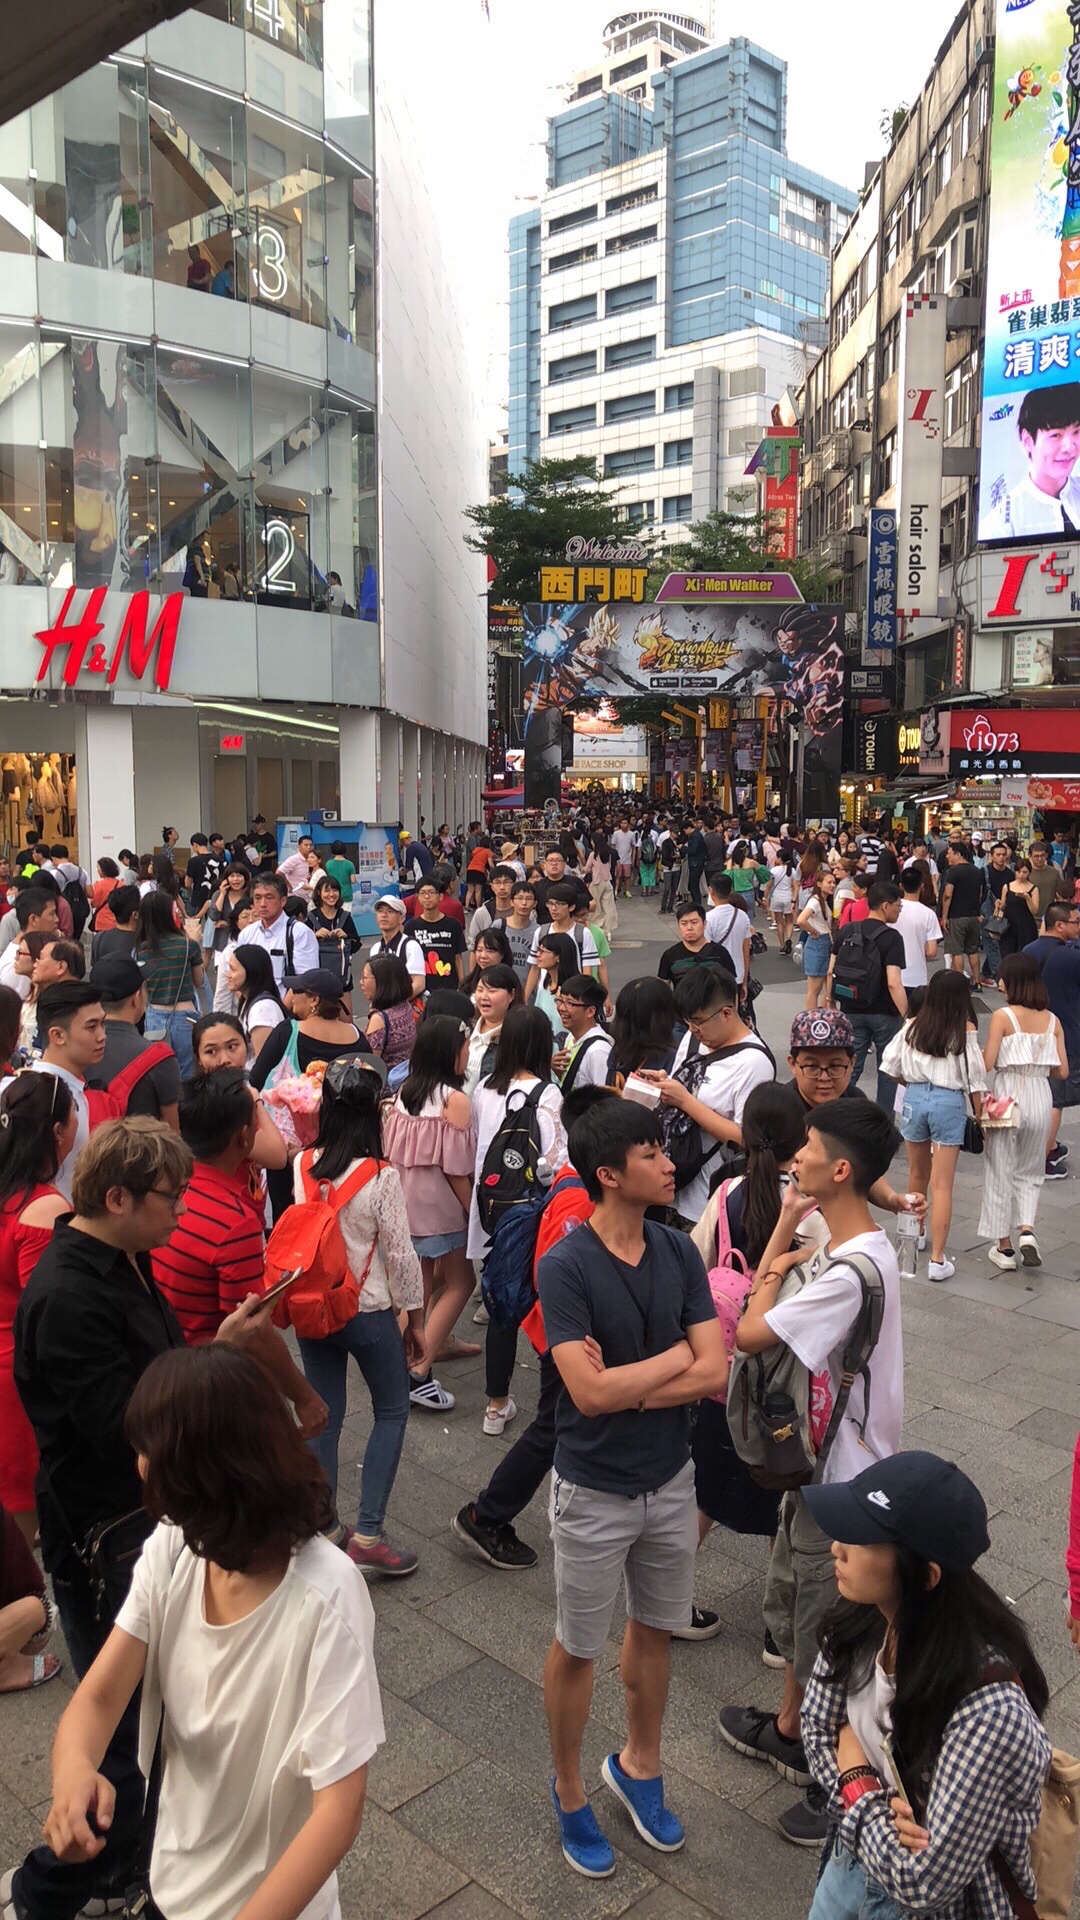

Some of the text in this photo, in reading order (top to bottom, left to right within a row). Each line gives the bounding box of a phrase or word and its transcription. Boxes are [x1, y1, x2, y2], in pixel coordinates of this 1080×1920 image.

[252, 225, 288, 301] 3
[1000, 288, 1033, 306] 新上市
[1004, 334, 1080, 378] 清爽
[261, 519, 296, 592] 2
[565, 535, 649, 563] Welcome
[908, 504, 929, 596] hair salon
[541, 566, 648, 603] 西門町
[684, 577, 773, 593] Xi-Men Walker
[870, 541, 896, 643] 雪龍眼鏡
[33, 585, 184, 692] H&M
[580, 760, 602, 768] FACE
[604, 760, 627, 768] SHOP
[866, 735, 875, 771] TOUGH
